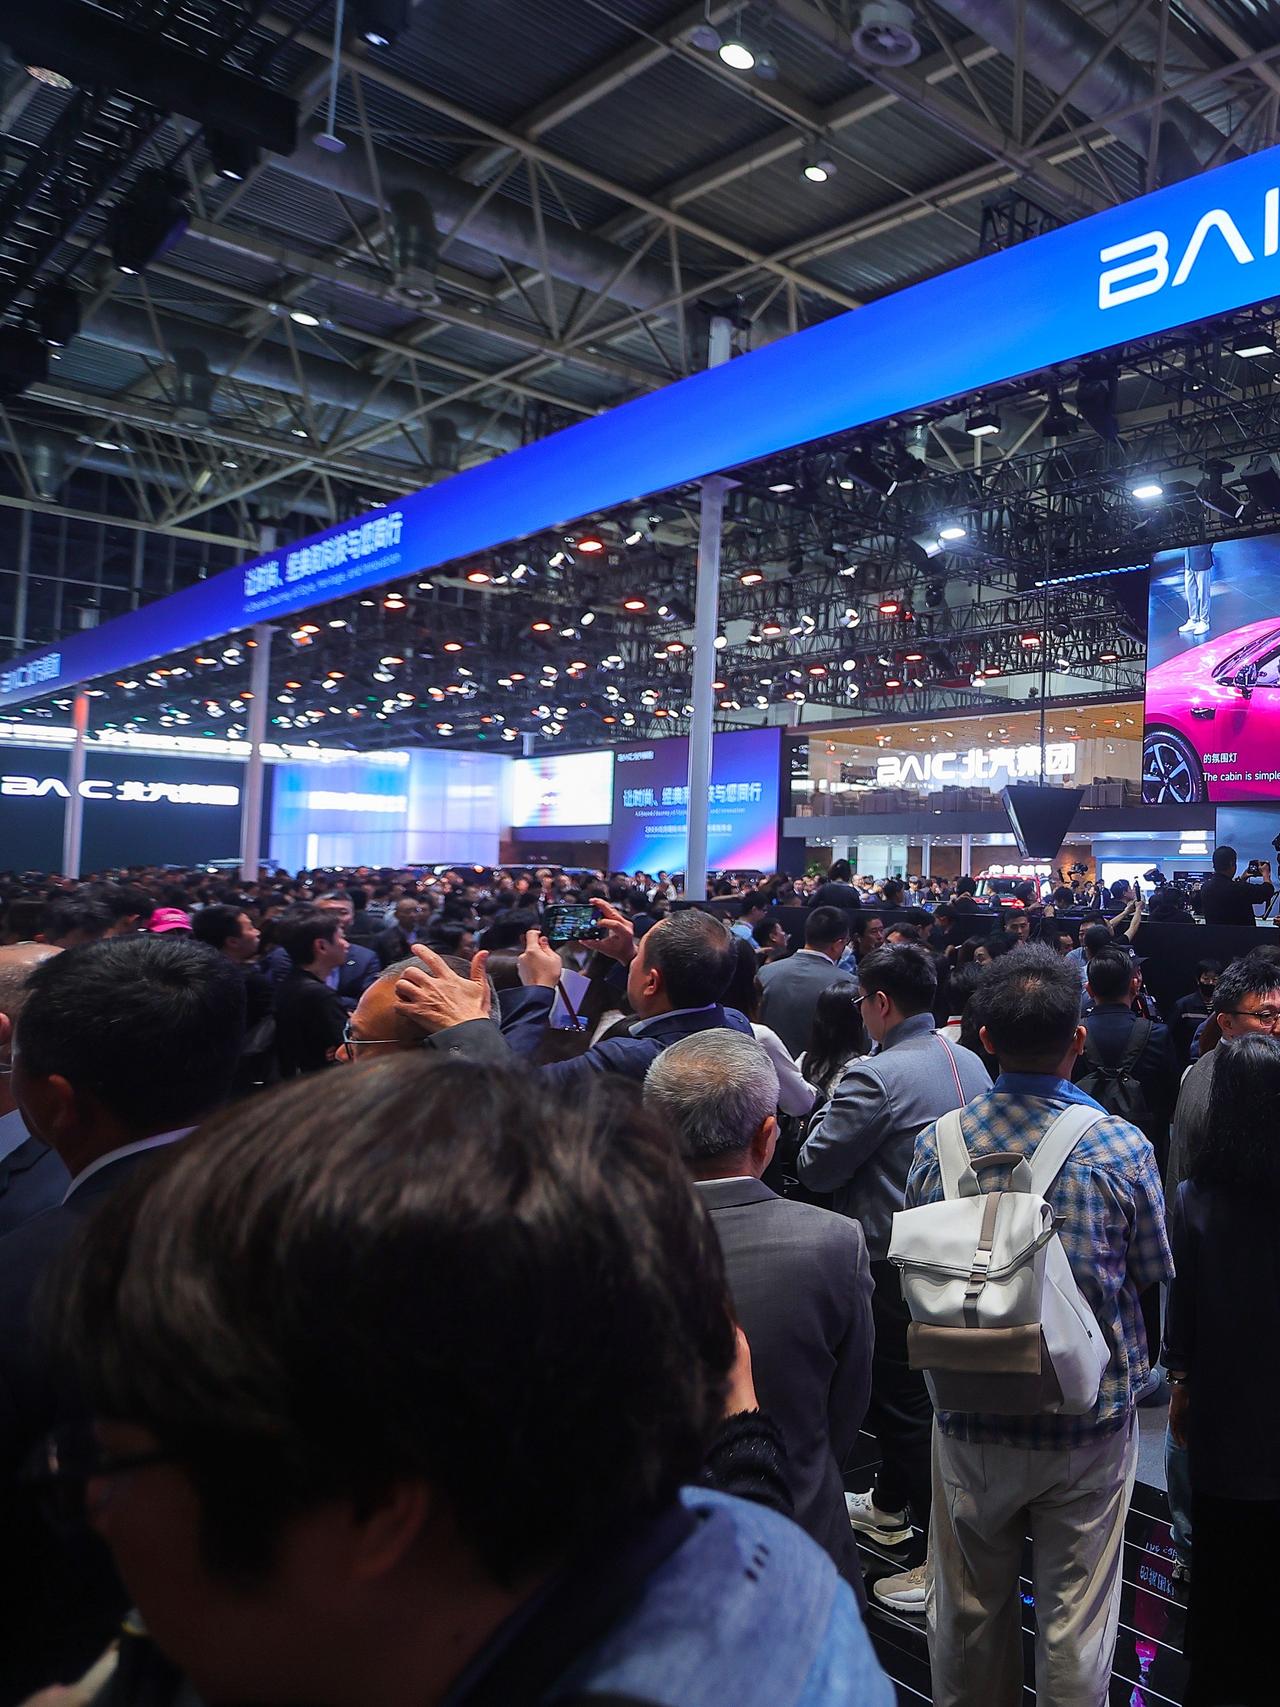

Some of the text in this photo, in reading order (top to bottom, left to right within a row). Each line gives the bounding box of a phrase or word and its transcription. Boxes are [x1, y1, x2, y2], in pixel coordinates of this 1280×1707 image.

[877, 752, 957, 784] BAIC
[1202, 772, 1218, 782] The
[1220, 772, 1242, 781] cabin
[1245, 771, 1252, 780] is
[1, 776, 113, 799] BAC
